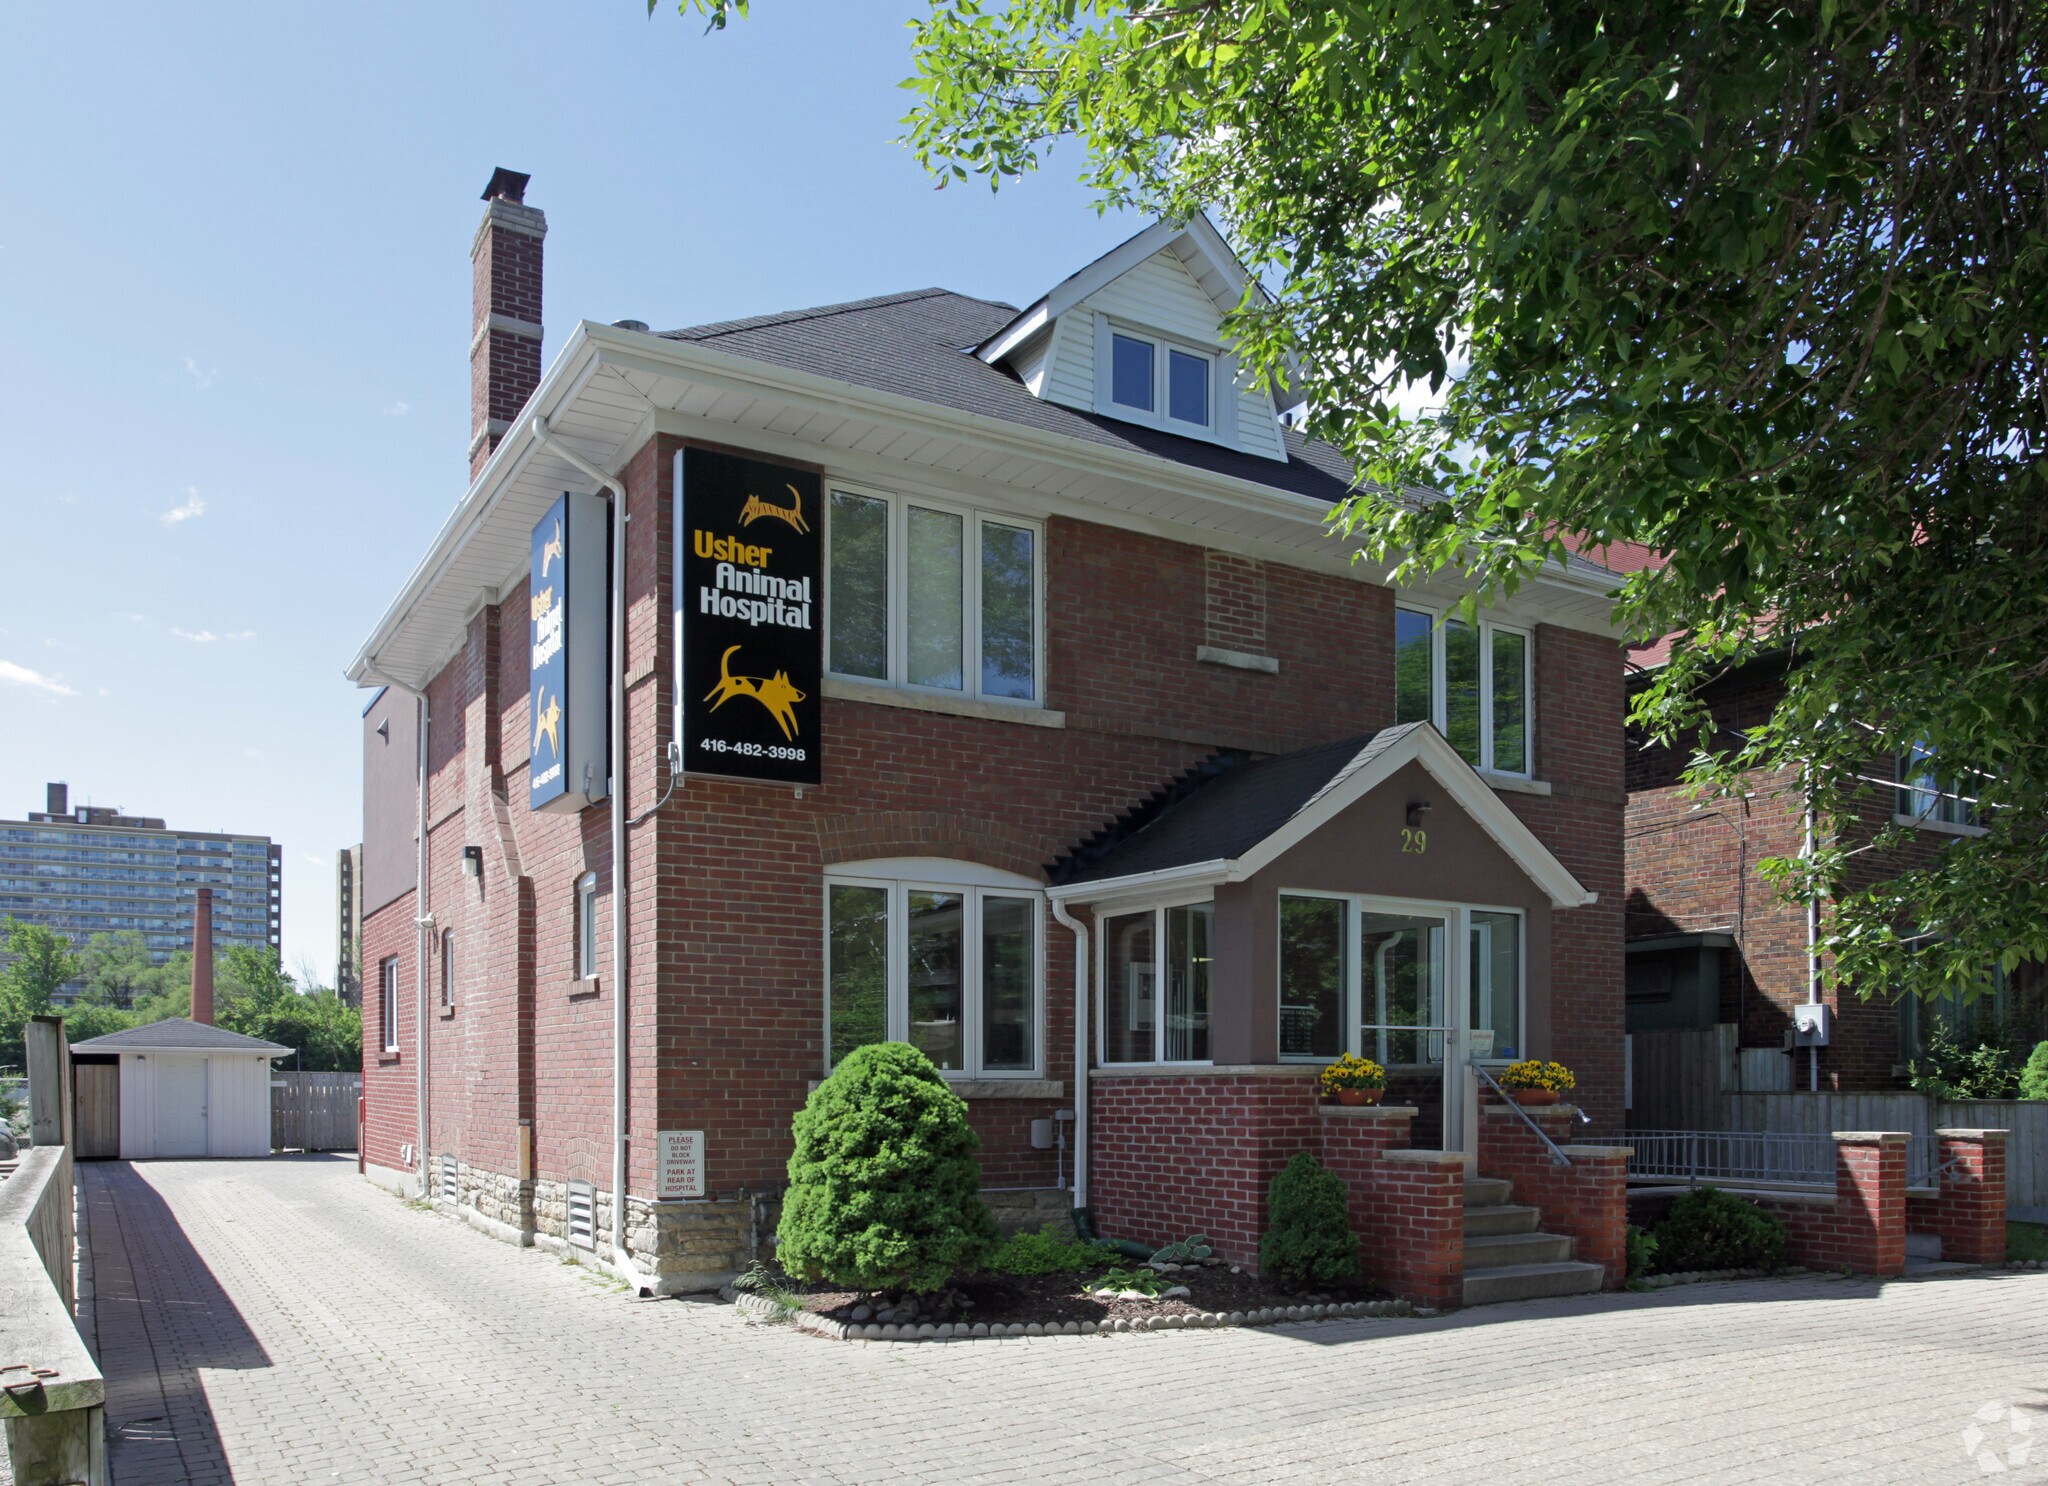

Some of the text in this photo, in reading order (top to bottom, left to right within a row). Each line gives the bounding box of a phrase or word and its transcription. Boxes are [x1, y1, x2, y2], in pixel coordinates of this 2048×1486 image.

[694, 529, 772, 568] Usher
[716, 562, 812, 603] Animal
[700, 586, 812, 630] Hospital
[700, 738, 806, 761] 416-482-3998
[1401, 828, 1427, 854] 29
